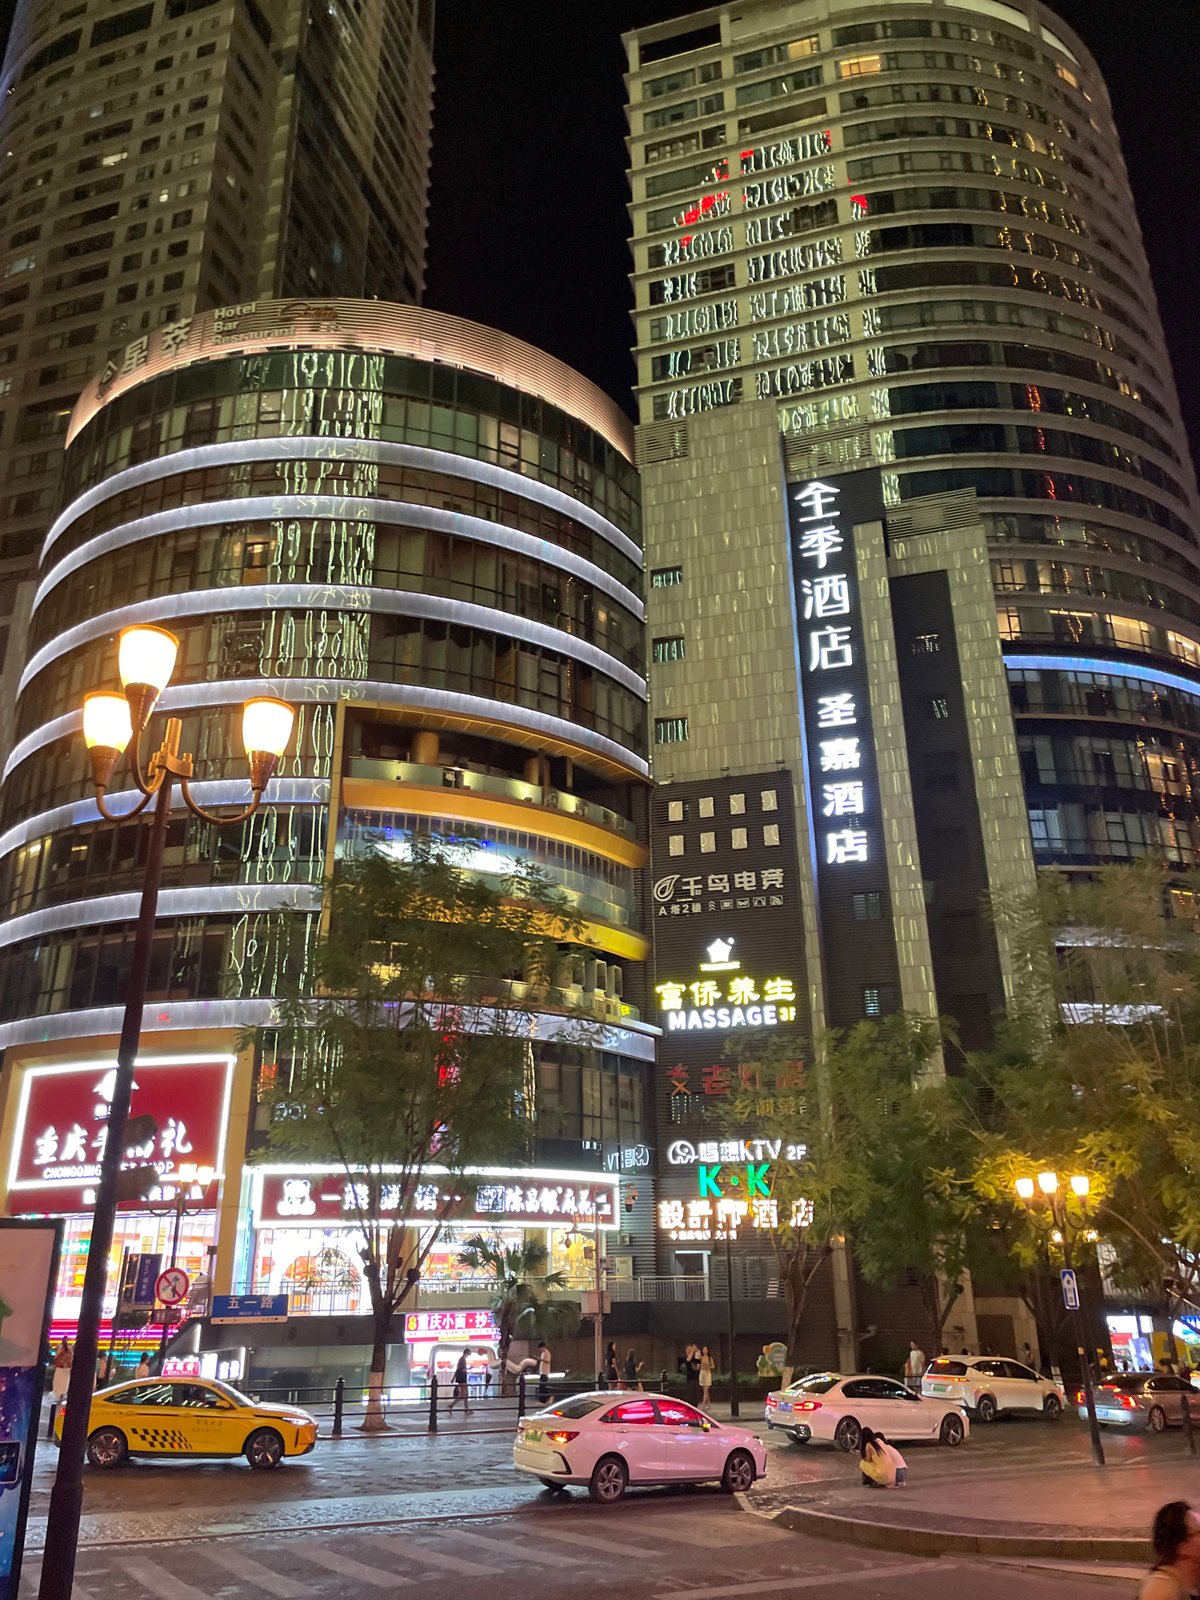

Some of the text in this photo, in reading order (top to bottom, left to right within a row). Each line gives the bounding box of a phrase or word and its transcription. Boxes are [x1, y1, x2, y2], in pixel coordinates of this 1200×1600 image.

[214, 301, 256, 320] Hotel
[213, 321, 240, 333] Bar
[795, 481, 854, 672] 全季酒店
[817, 692, 868, 864] 圣嘉酒店
[681, 868, 784, 897] 千鸟电竞
[655, 976, 797, 1010] 富侨养生
[668, 1005, 778, 1031] MASSAGE
[786, 1144, 807, 1161] 2F
[227, 1296, 274, 1309] 五一路
